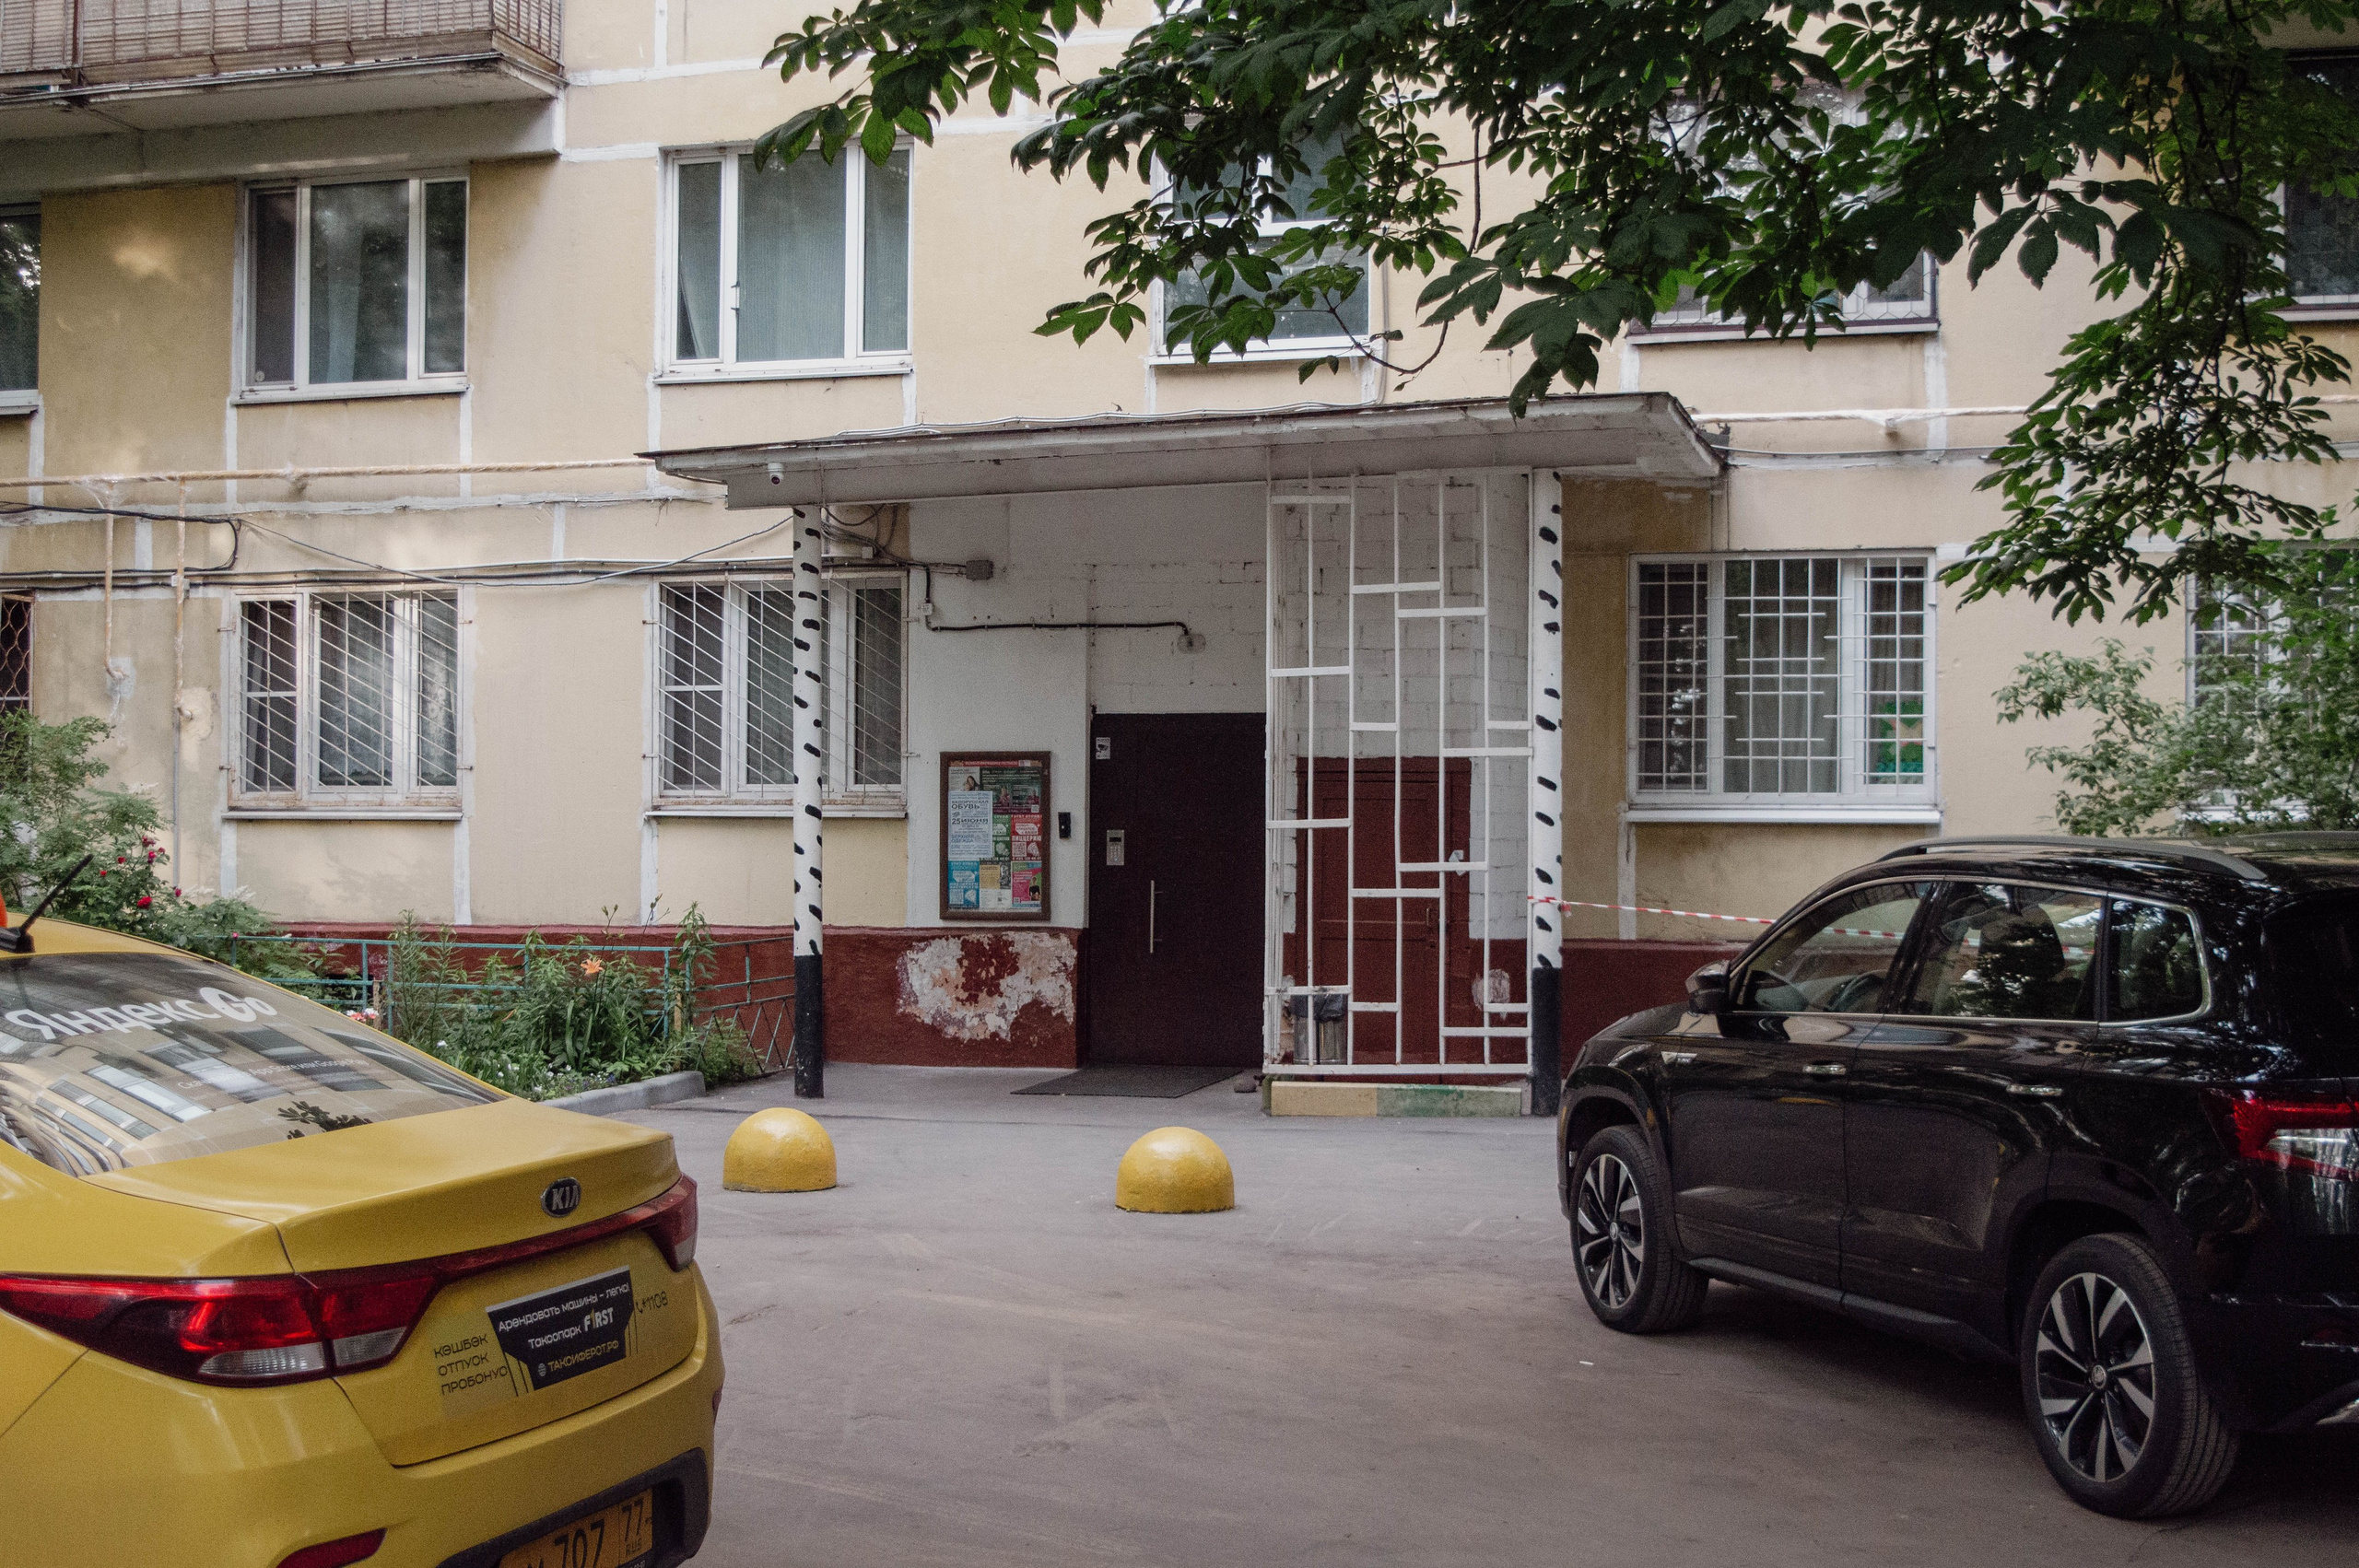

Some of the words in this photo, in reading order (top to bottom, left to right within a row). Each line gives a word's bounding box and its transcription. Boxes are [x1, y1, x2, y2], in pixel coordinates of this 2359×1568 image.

[952, 817, 961, 825] 25
[6, 999, 221, 1040] Яндекс
[200, 987, 277, 1022] Go
[552, 1185, 580, 1211] KIA
[499, 1305, 561, 1332] Арендовать
[561, 1293, 598, 1312] машины
[606, 1282, 630, 1299] легко!
[528, 1324, 582, 1350] Таксопарк
[438, 1352, 489, 1377] ОТПУСК
[621, 1497, 644, 1543] 77
[626, 1537, 642, 1555] RUS
